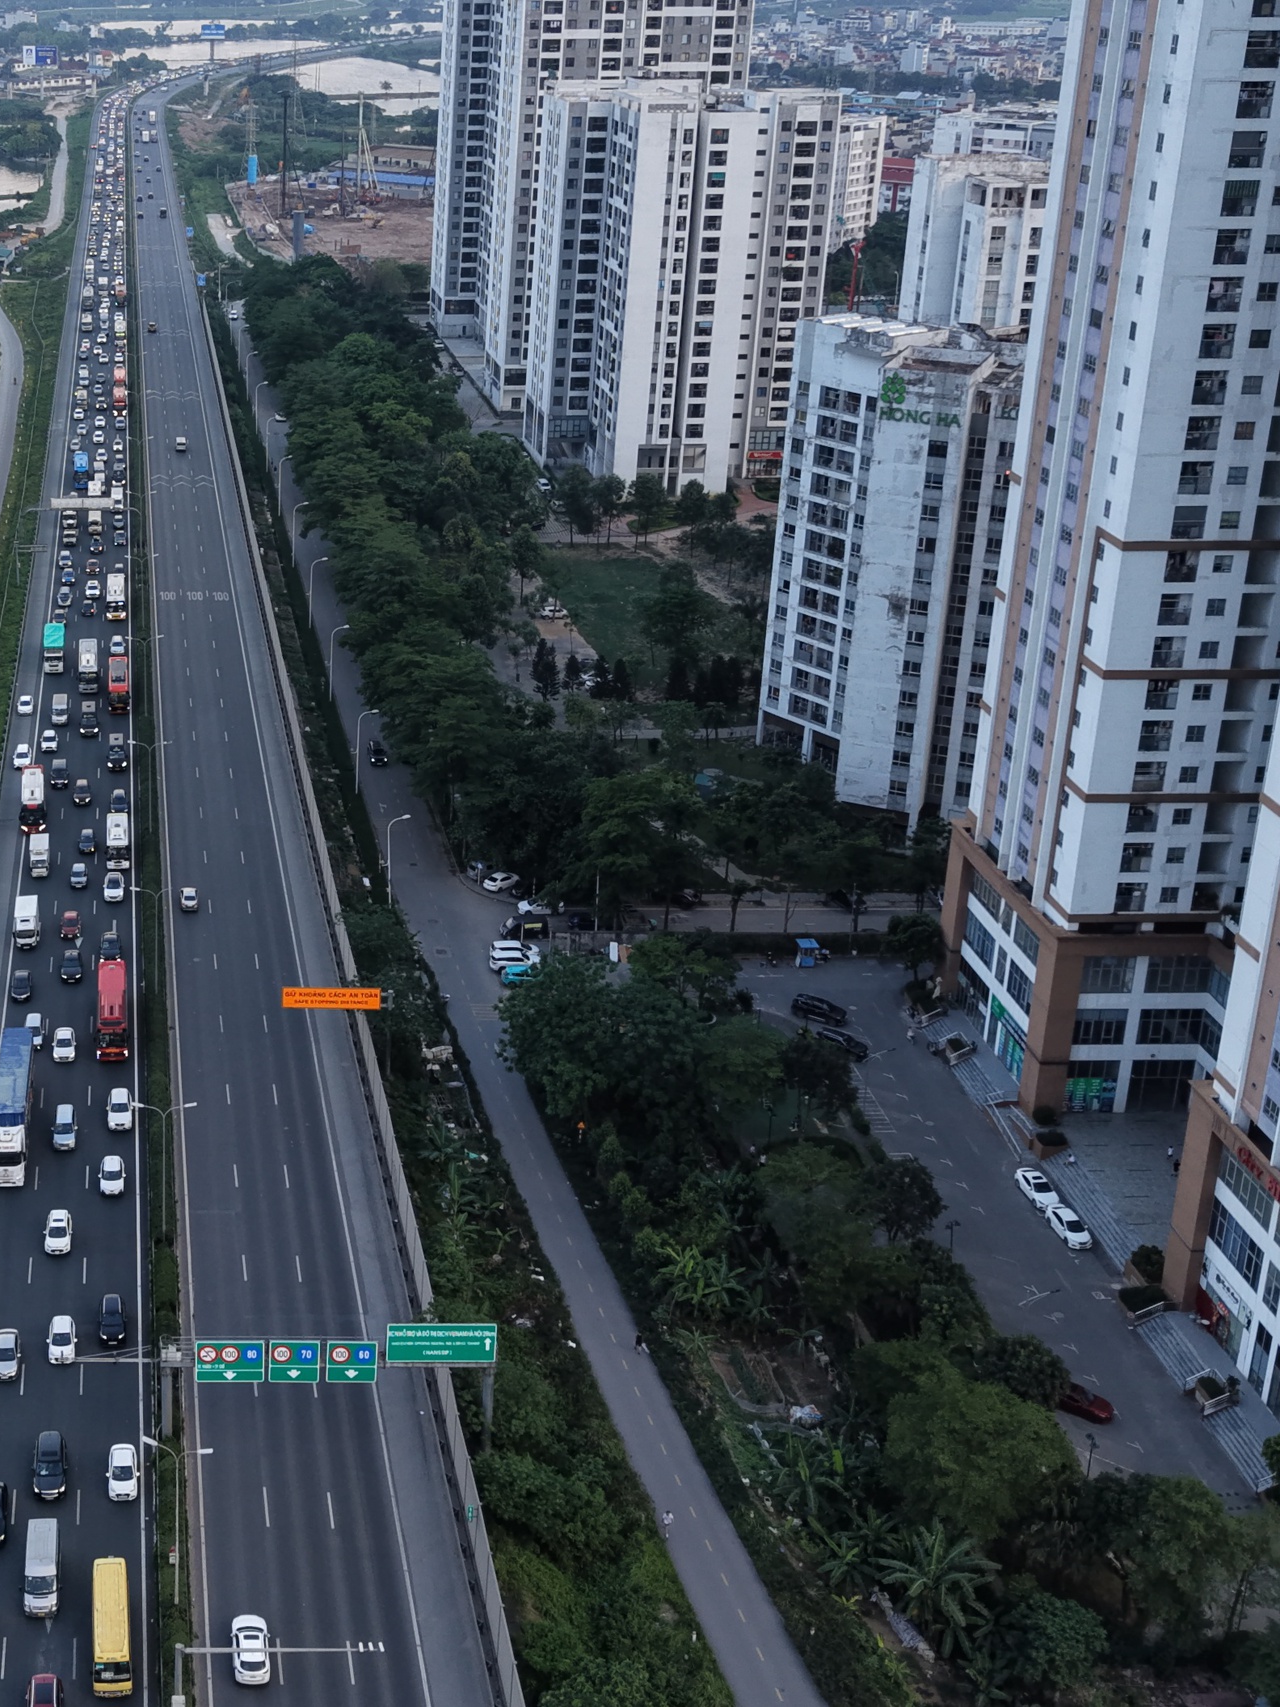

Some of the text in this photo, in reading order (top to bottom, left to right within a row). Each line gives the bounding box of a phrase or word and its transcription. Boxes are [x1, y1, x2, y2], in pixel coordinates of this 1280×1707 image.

[159, 591, 176, 600] 100
[187, 591, 203, 601] 100
[212, 592, 229, 601] 100
[224, 1350, 236, 1358] 100
[247, 1350, 257, 1358] 80
[276, 1350, 288, 1358] 100
[301, 1350, 312, 1358] 70
[359, 1350, 369, 1359] 60
